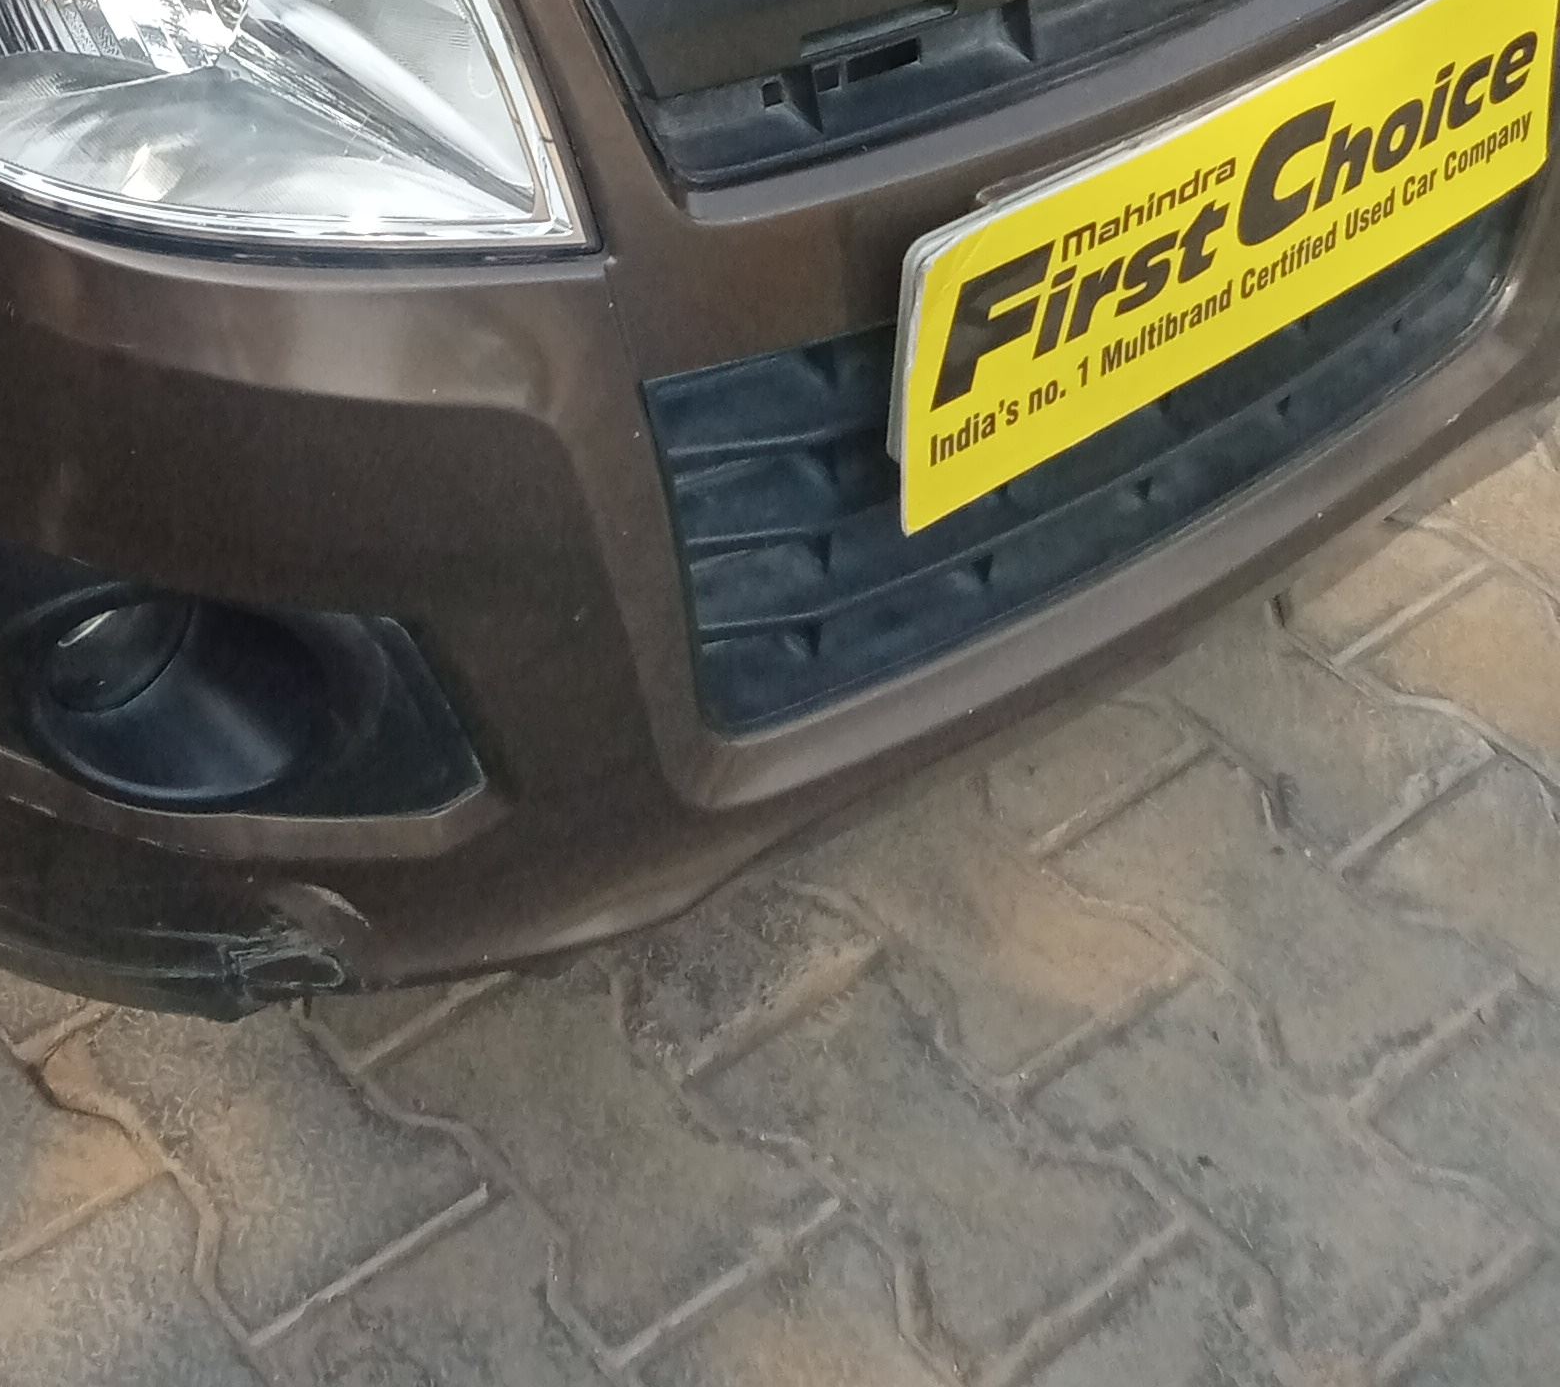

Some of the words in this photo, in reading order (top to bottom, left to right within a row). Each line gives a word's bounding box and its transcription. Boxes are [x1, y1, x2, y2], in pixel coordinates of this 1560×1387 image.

[929, 399, 1019, 467] India's
[1027, 380, 1067, 416] no.
[1076, 356, 1090, 389] 1
[1100, 279, 1234, 377] Multibrand
[1240, 221, 1337, 299] Certified
[1345, 190, 1396, 241] Used
[1402, 168, 1438, 207] Car
[1443, 111, 1532, 182] Company
[930, 199, 1230, 412] First
[1237, 31, 1538, 247] Choice
